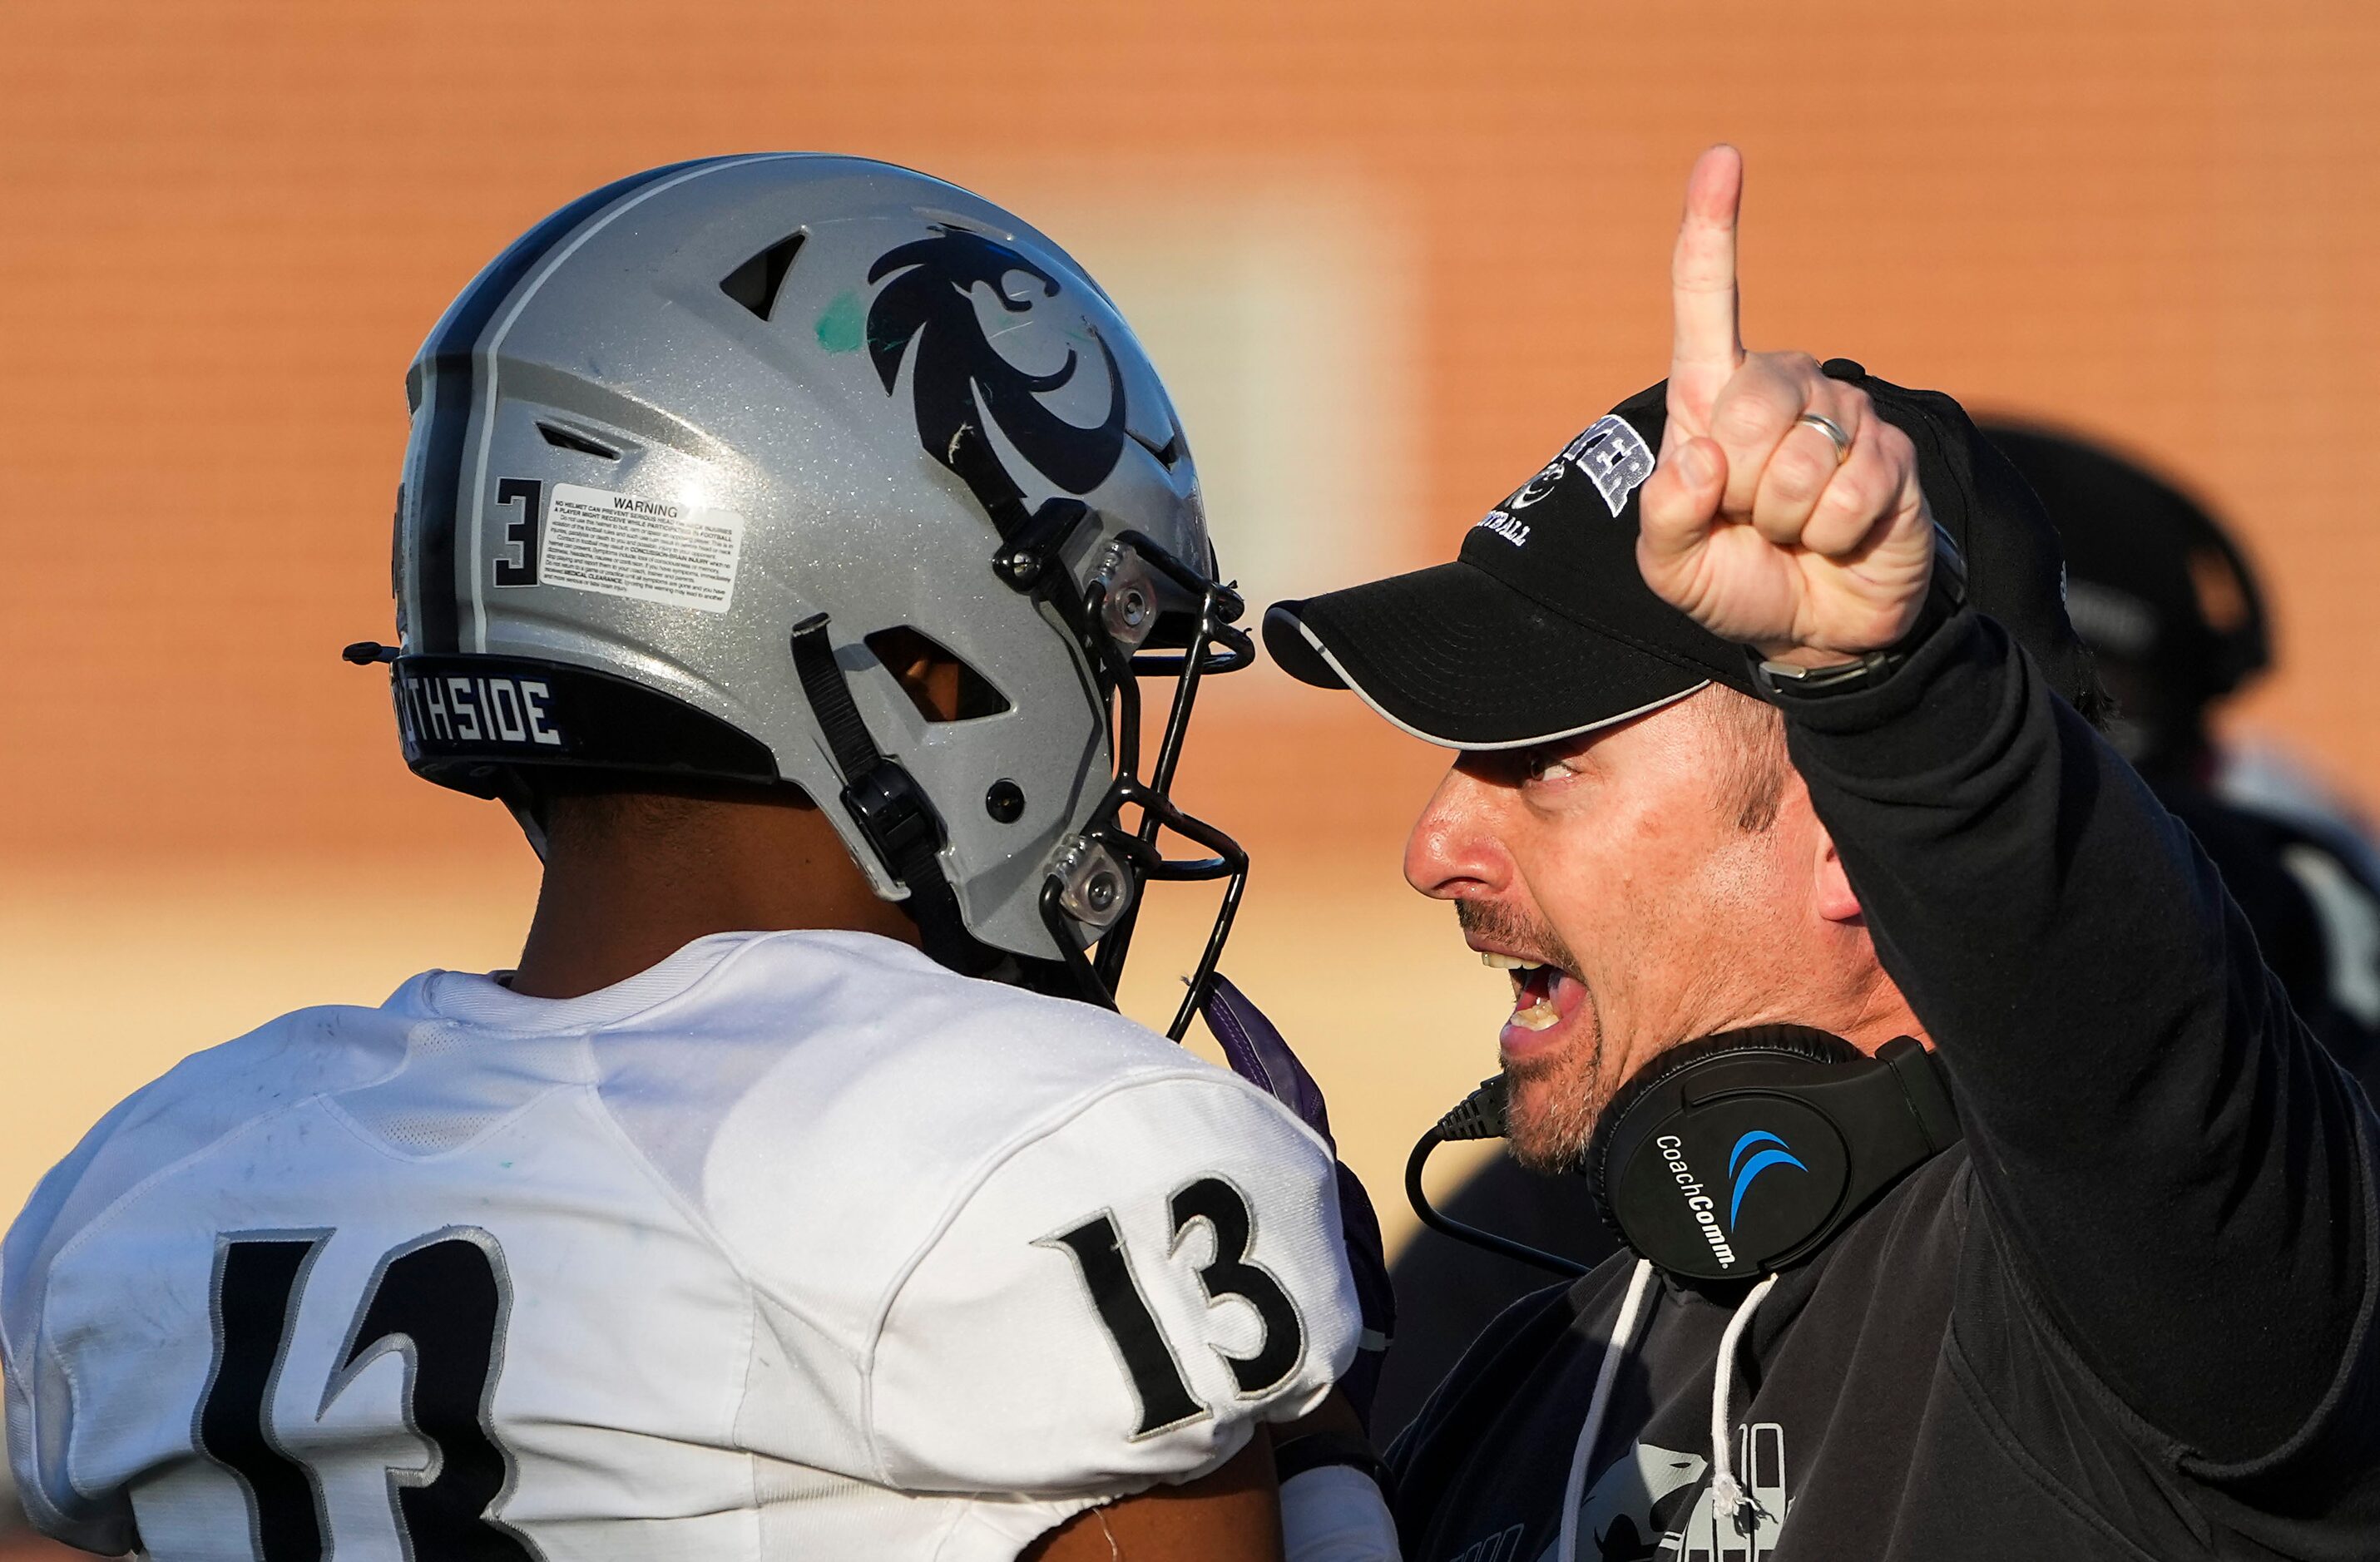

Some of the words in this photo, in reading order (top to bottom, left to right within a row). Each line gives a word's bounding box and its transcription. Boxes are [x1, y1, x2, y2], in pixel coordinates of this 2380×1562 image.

[493, 477, 542, 588] 3
[601, 515, 626, 523] RECEIVE
[602, 508, 628, 517] PREVENT
[631, 513, 656, 522] SERIOUS
[614, 498, 679, 518] WARNING
[1029, 1170, 1309, 1442] 13
[190, 1224, 549, 1562] 13
